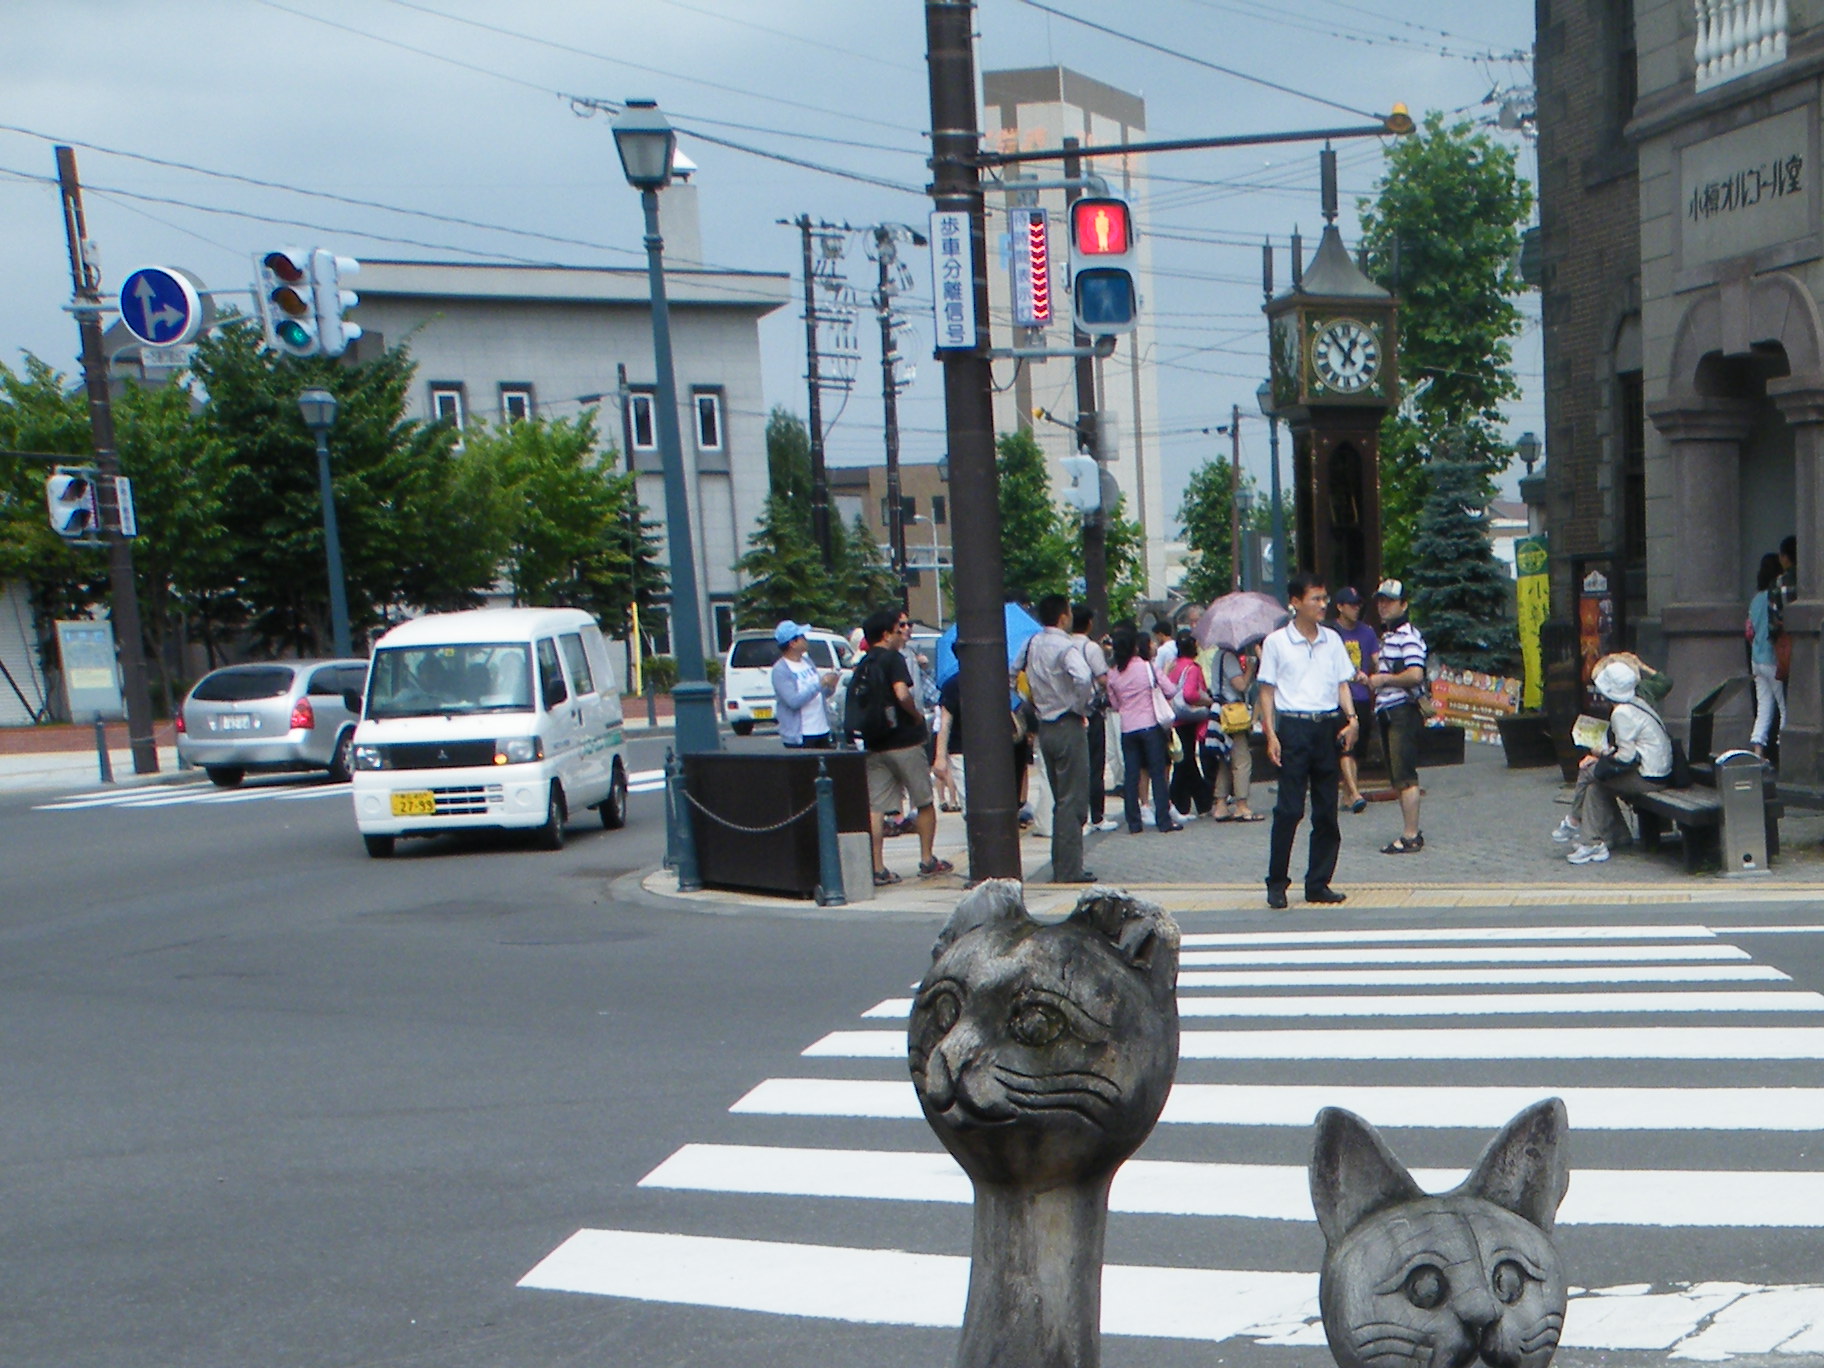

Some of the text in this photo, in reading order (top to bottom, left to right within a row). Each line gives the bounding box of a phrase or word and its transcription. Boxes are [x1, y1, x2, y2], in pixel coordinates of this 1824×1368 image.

[941, 217, 965, 344] 歩車分離信号
